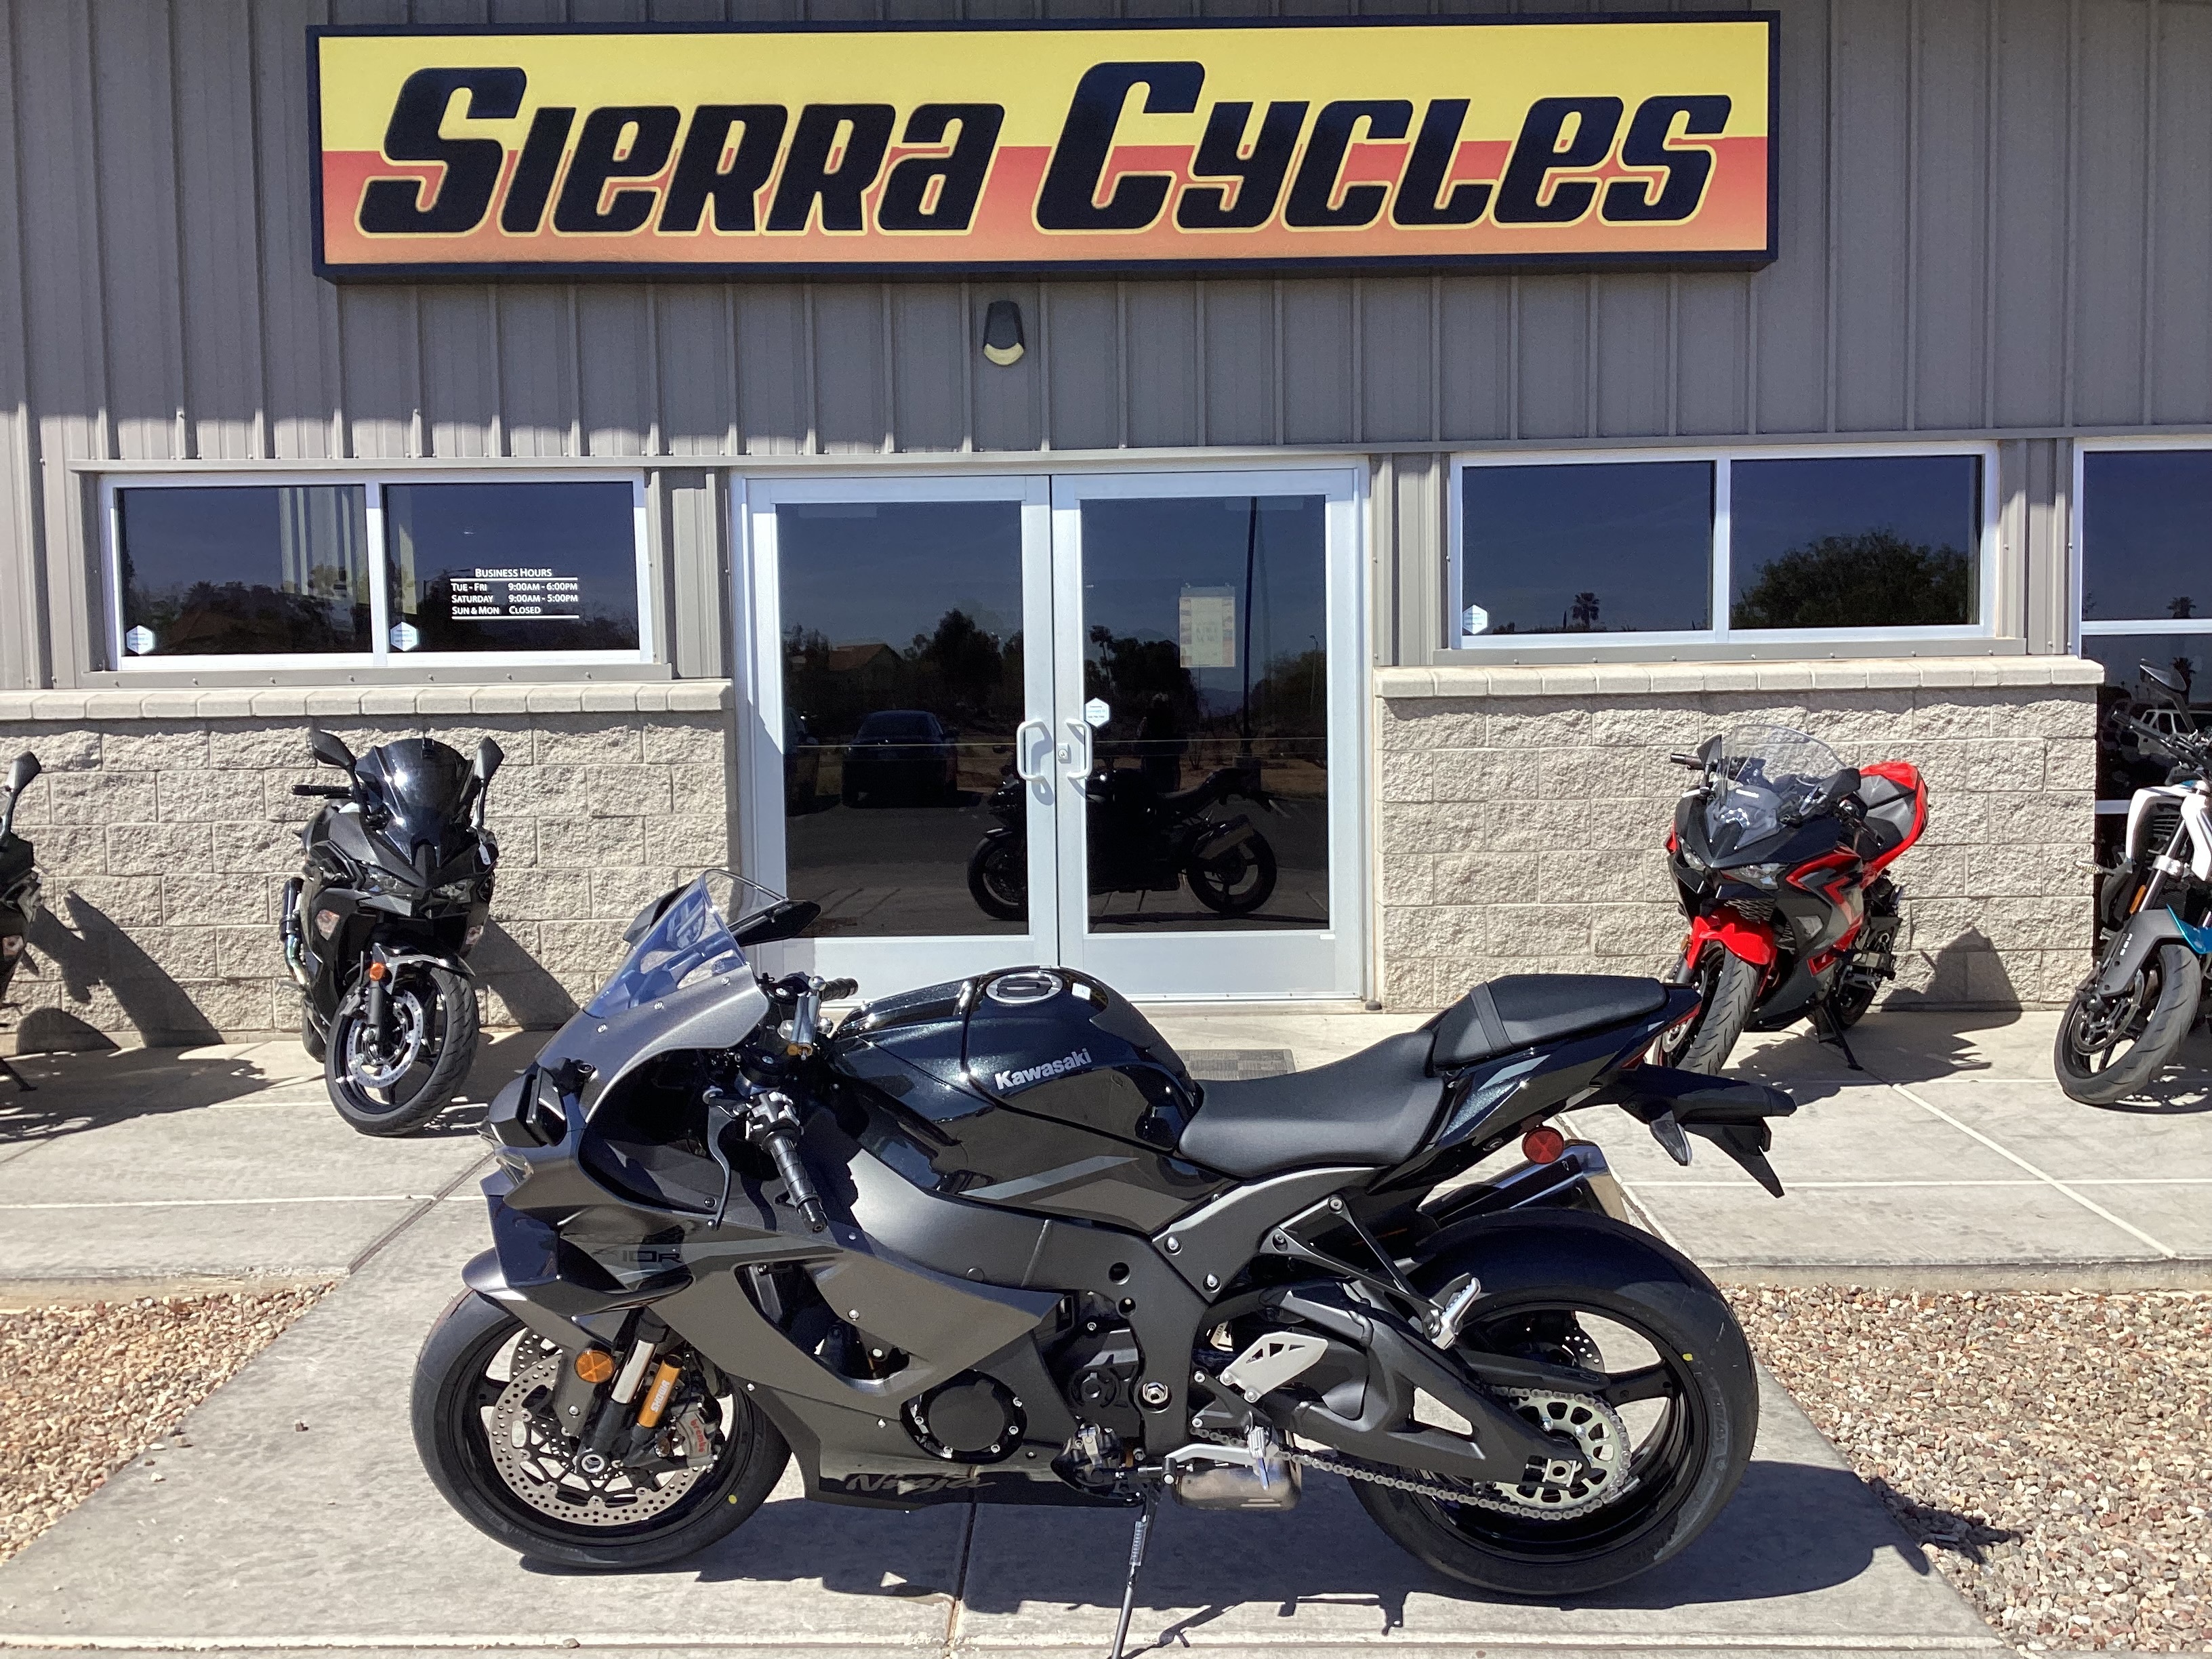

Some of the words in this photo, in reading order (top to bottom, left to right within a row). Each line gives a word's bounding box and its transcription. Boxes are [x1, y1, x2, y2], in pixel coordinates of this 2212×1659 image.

[508, 582, 540, 591] 9:00AM
[546, 582, 577, 591] 6:00PM
[451, 594, 493, 603] SATURDAY
[508, 594, 540, 602] 9:00AM
[547, 594, 578, 602] 5:00PM
[452, 607, 470, 615] SUN
[471, 607, 477, 615] &
[478, 606, 499, 615] MON
[509, 606, 541, 614] CLOSED
[994, 1048, 1092, 1090] Kawasaki
